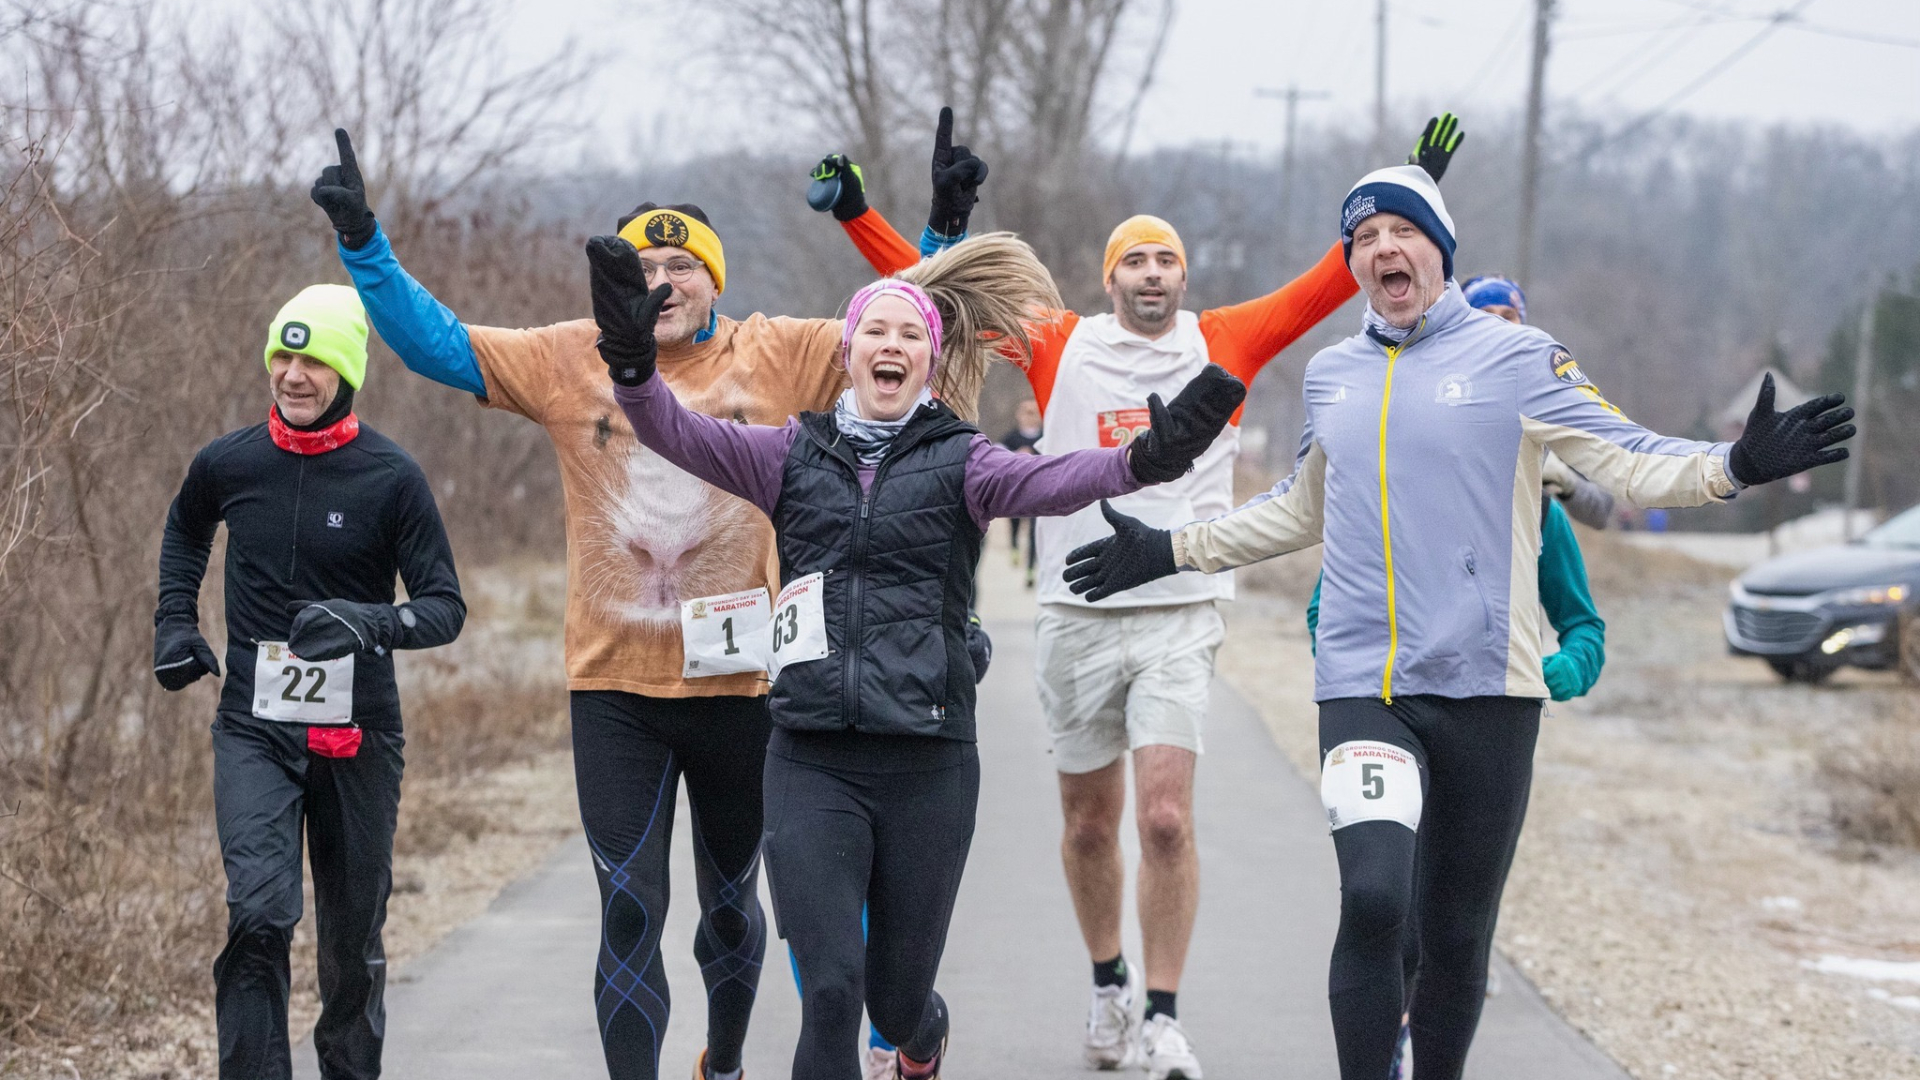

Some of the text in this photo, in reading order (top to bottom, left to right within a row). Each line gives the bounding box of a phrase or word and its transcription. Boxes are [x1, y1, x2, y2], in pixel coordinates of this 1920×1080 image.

[707, 597, 739, 606] GROUNDHOG
[714, 599, 756, 612] MARATHON
[778, 585, 809, 608] MARATHON
[722, 617, 740, 655] 1
[772, 603, 799, 654] 63
[281, 665, 327, 704] 22
[1353, 750, 1406, 764] MARATHON
[1362, 763, 1385, 800] 5
